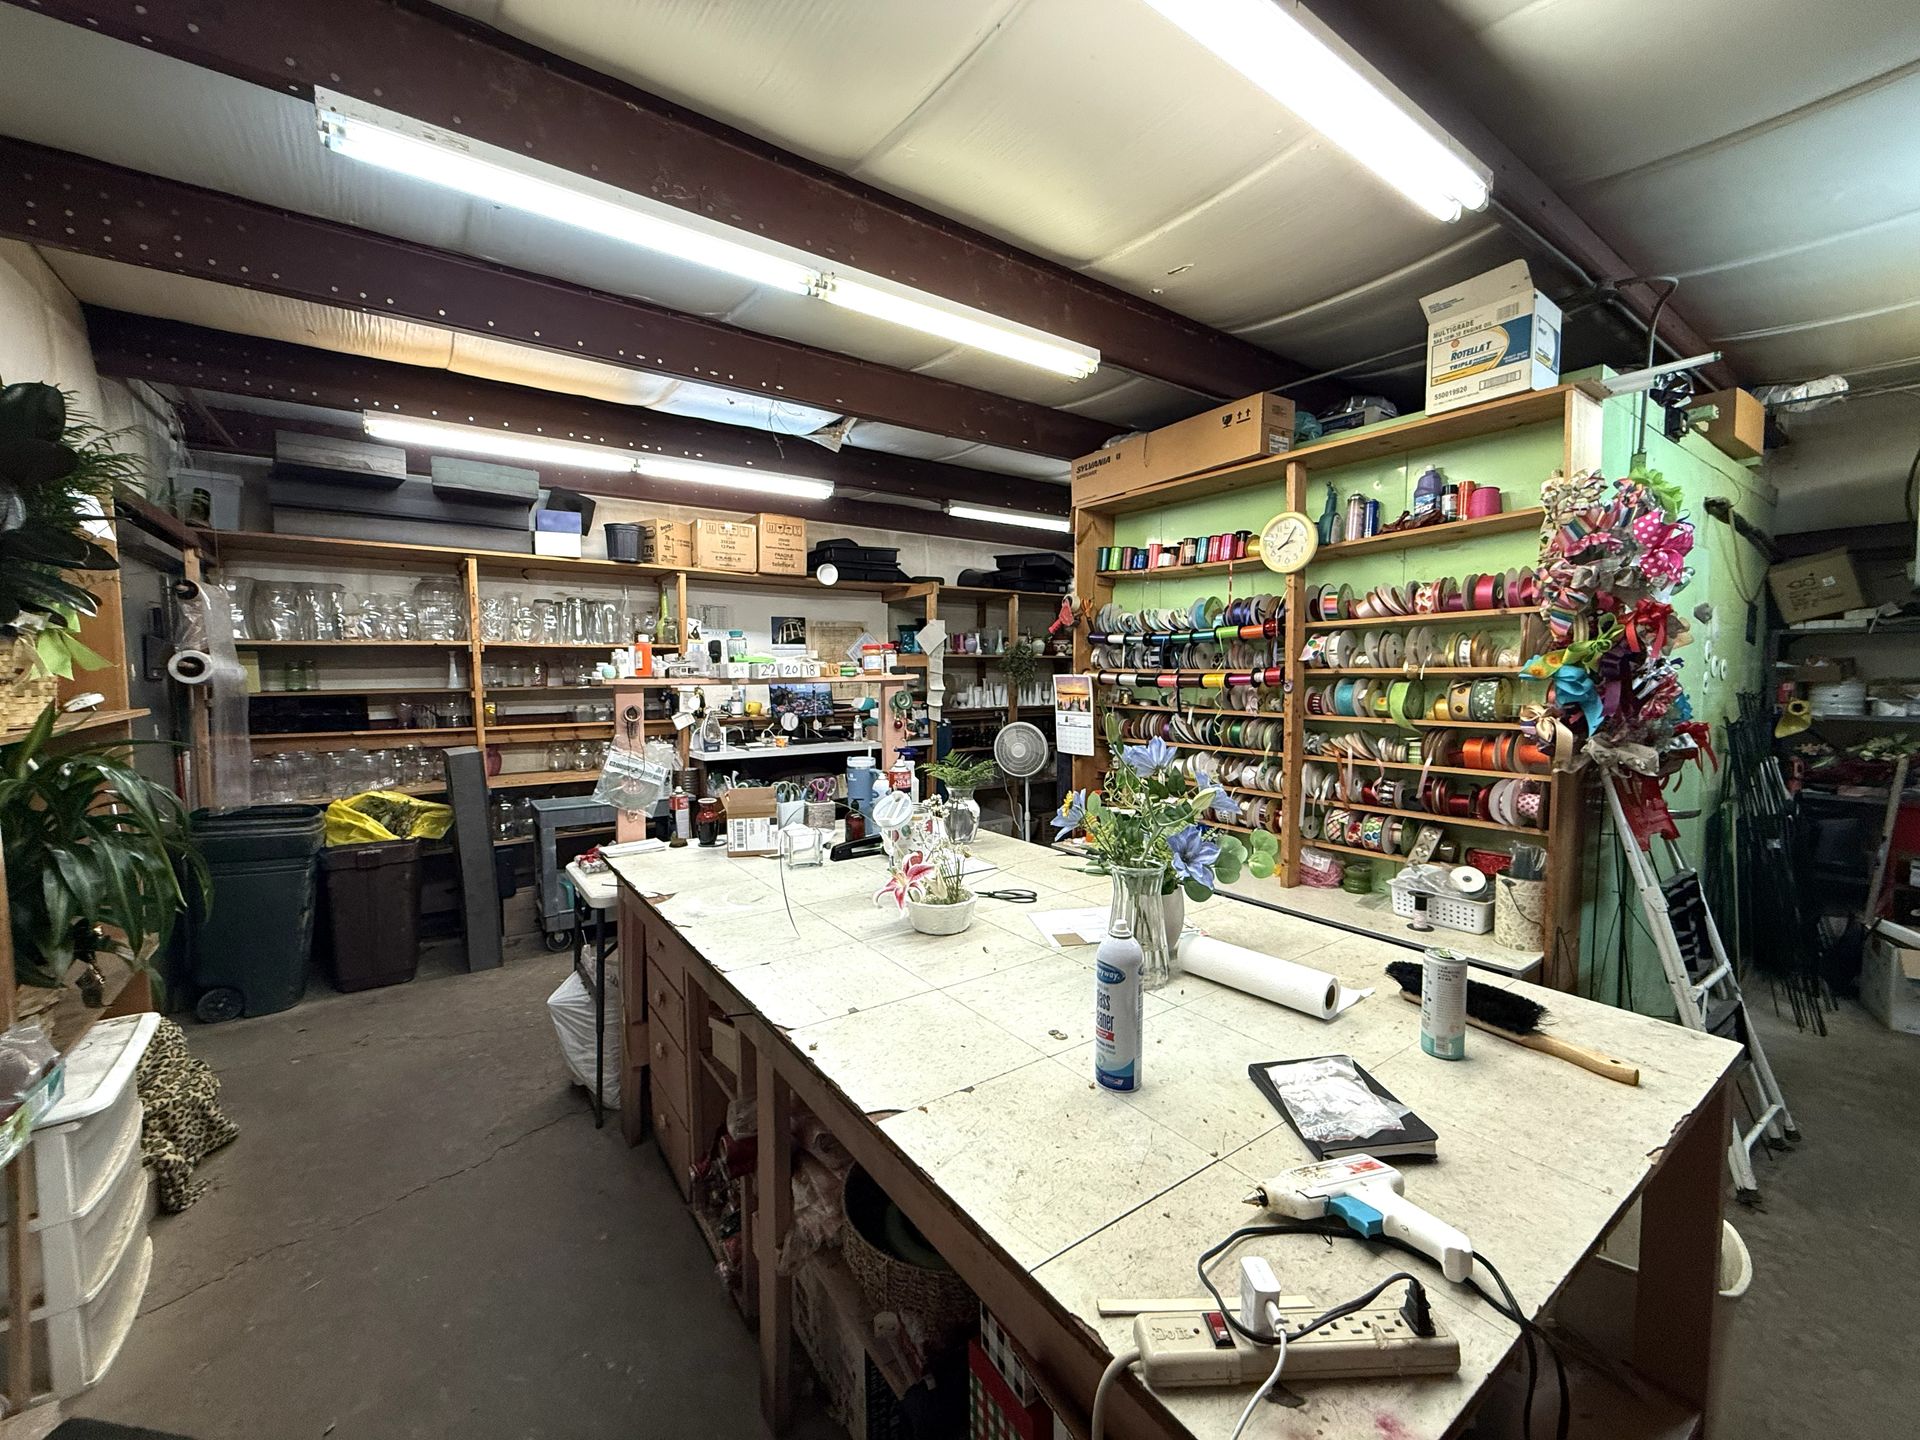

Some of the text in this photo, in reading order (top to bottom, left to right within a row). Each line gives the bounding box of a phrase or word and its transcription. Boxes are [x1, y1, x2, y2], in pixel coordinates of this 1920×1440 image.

[1433, 320, 1474, 338] MULTIGRADE
[1451, 346, 1484, 361] ROTELLA
[1449, 359, 1473, 371] TRIPLE
[1076, 456, 1110, 474] SYLVANIA
[785, 665, 798, 675] 20
[806, 664, 815, 676] 18
[829, 663, 839, 675] 16
